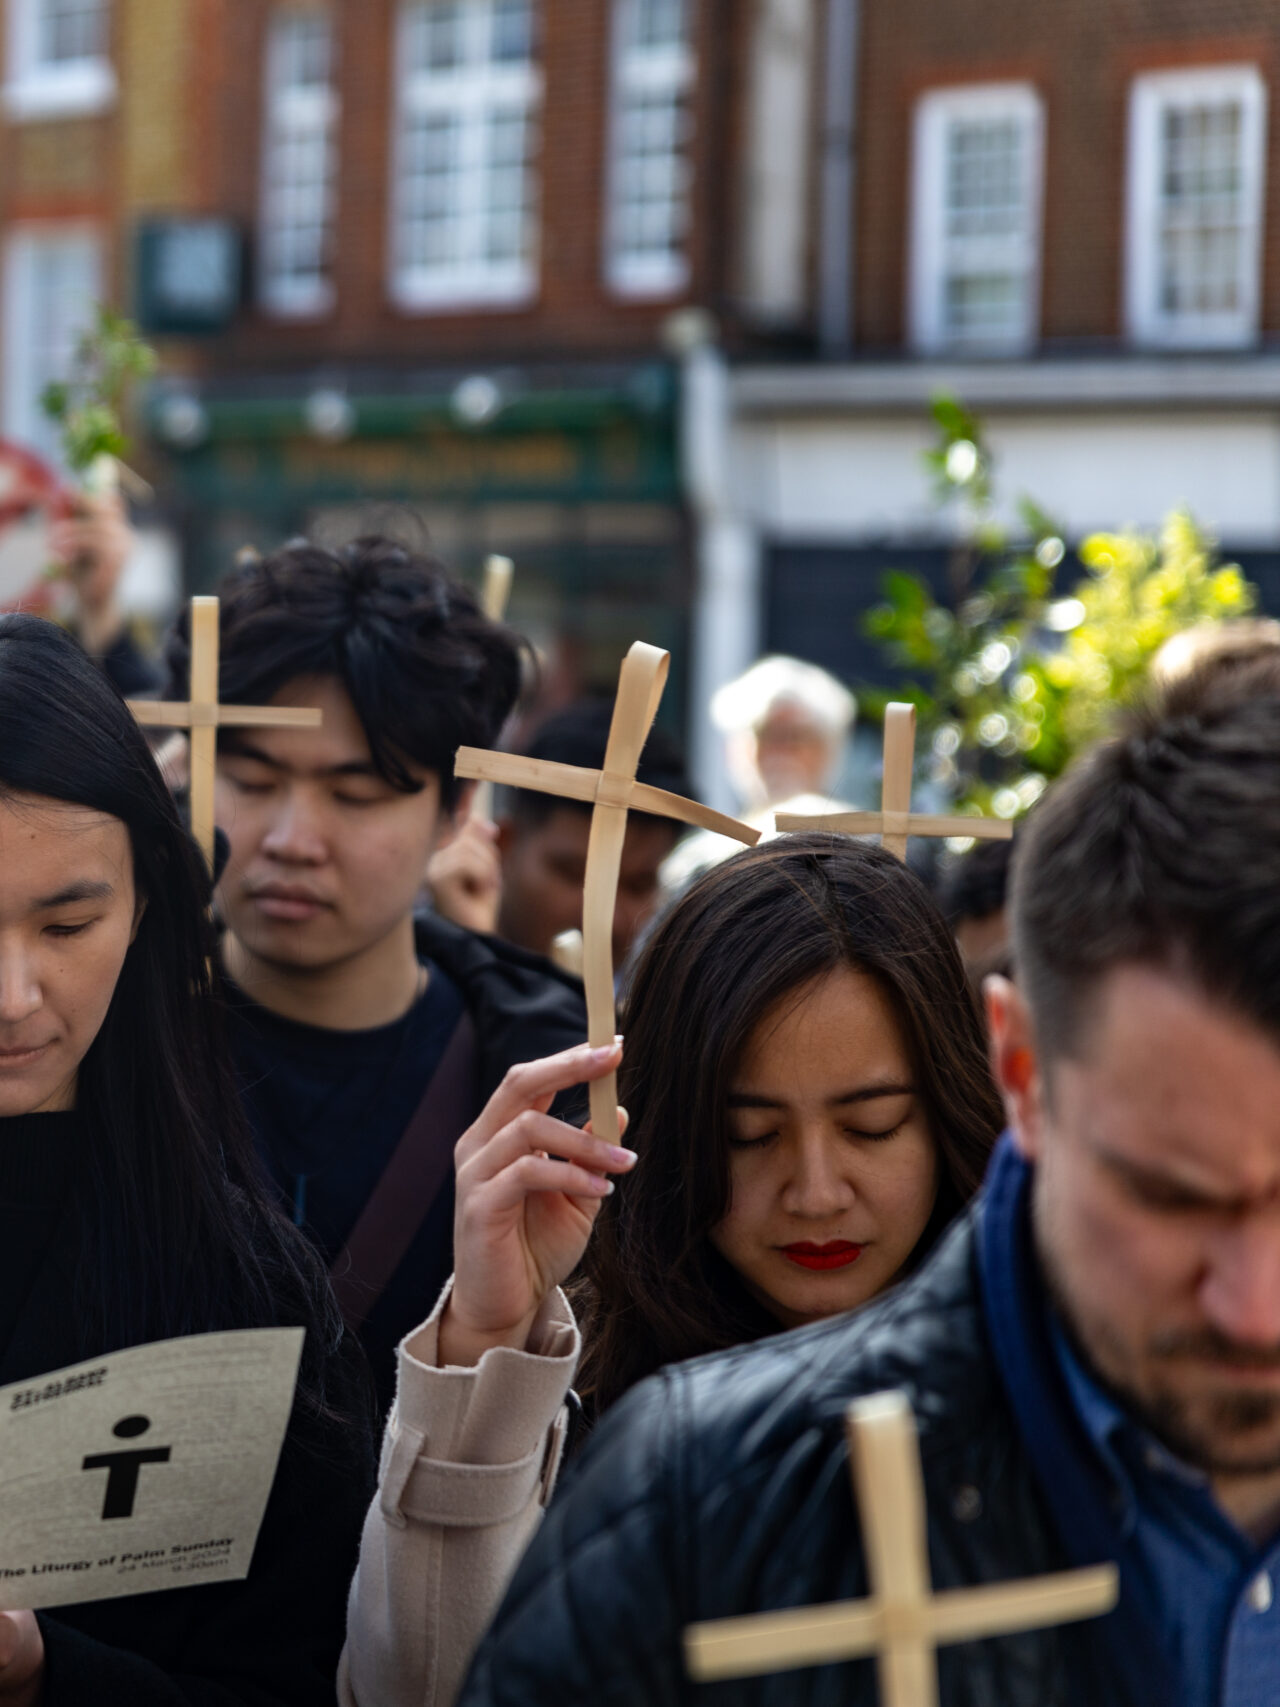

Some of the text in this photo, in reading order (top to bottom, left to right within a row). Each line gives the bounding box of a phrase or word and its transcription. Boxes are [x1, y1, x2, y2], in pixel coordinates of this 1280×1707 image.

[32, 1560, 93, 1576] Liturgy
[98, 1555, 117, 1567] of
[121, 1549, 165, 1563] Palm
[171, 1537, 234, 1554] Sunday
[142, 1555, 187, 1569] March
